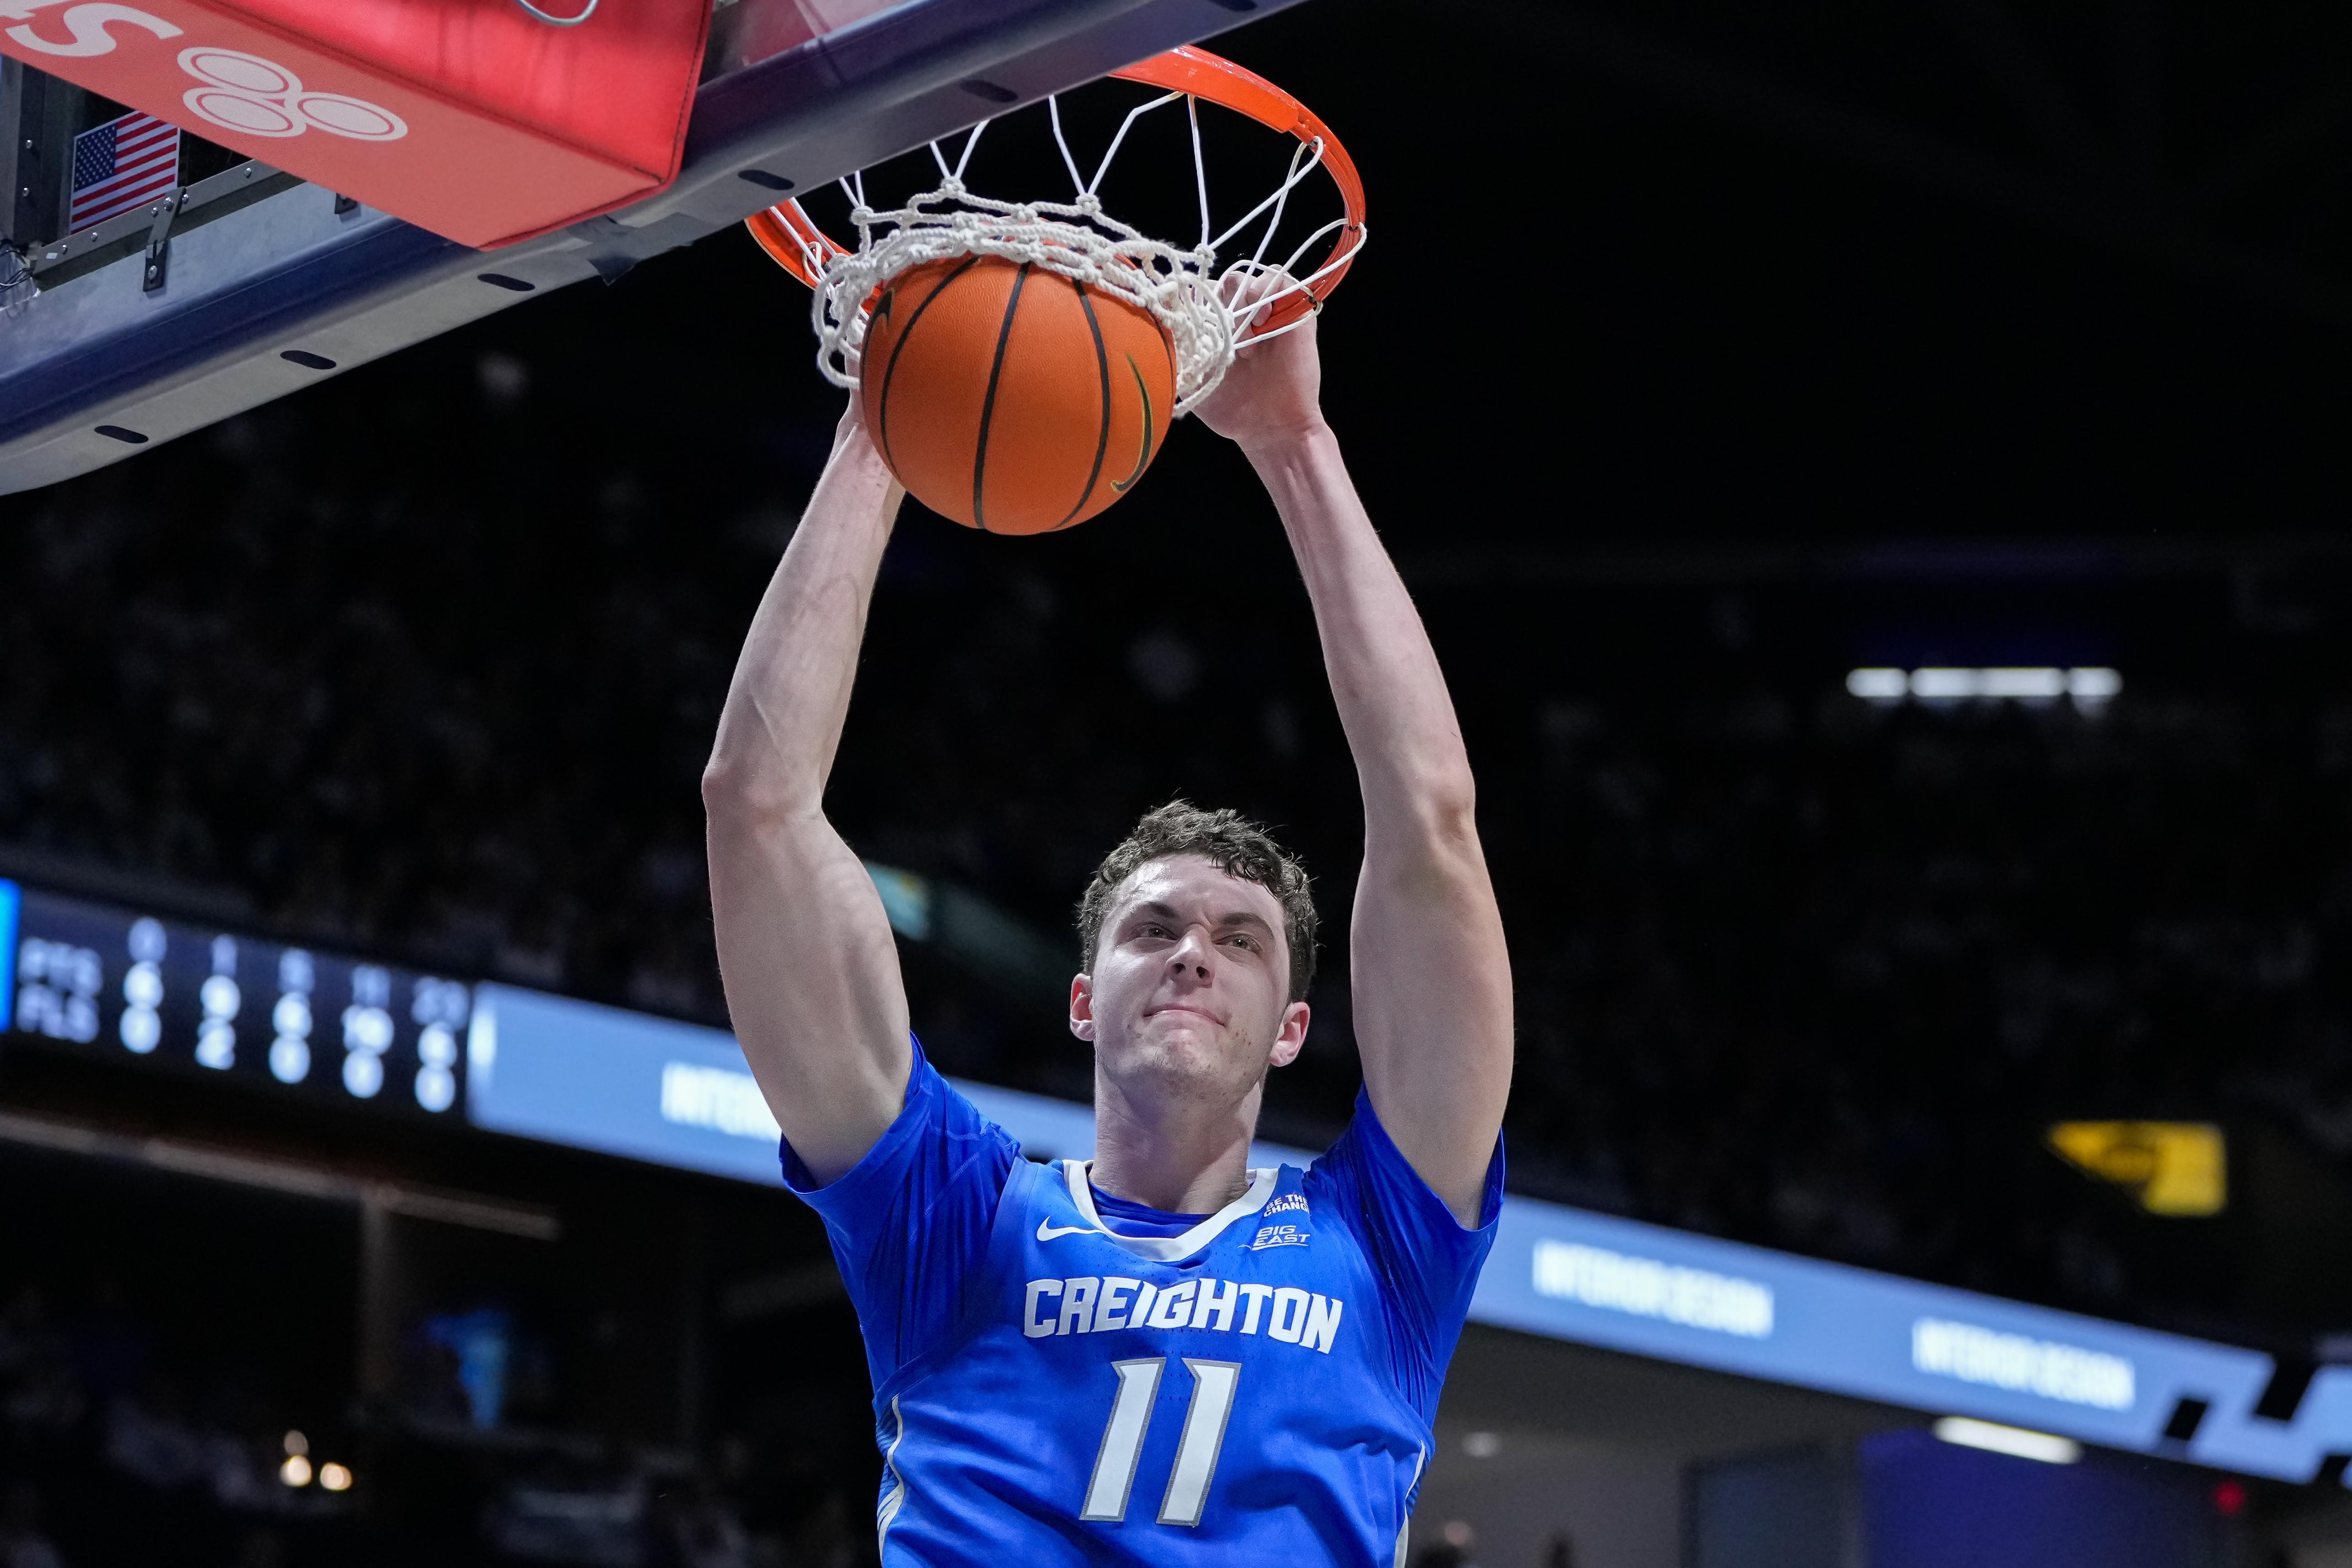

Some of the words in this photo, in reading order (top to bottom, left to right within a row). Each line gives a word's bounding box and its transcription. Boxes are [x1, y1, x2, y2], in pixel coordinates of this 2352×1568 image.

[1266, 1197, 1283, 1210] BE
[1285, 1194, 1308, 1205] THE
[1256, 1225, 1296, 1238] BIG
[1253, 1234, 1310, 1247] EAST
[1024, 1276, 1343, 1354] CREIGHTON
[1079, 1357, 1241, 1528] 11
